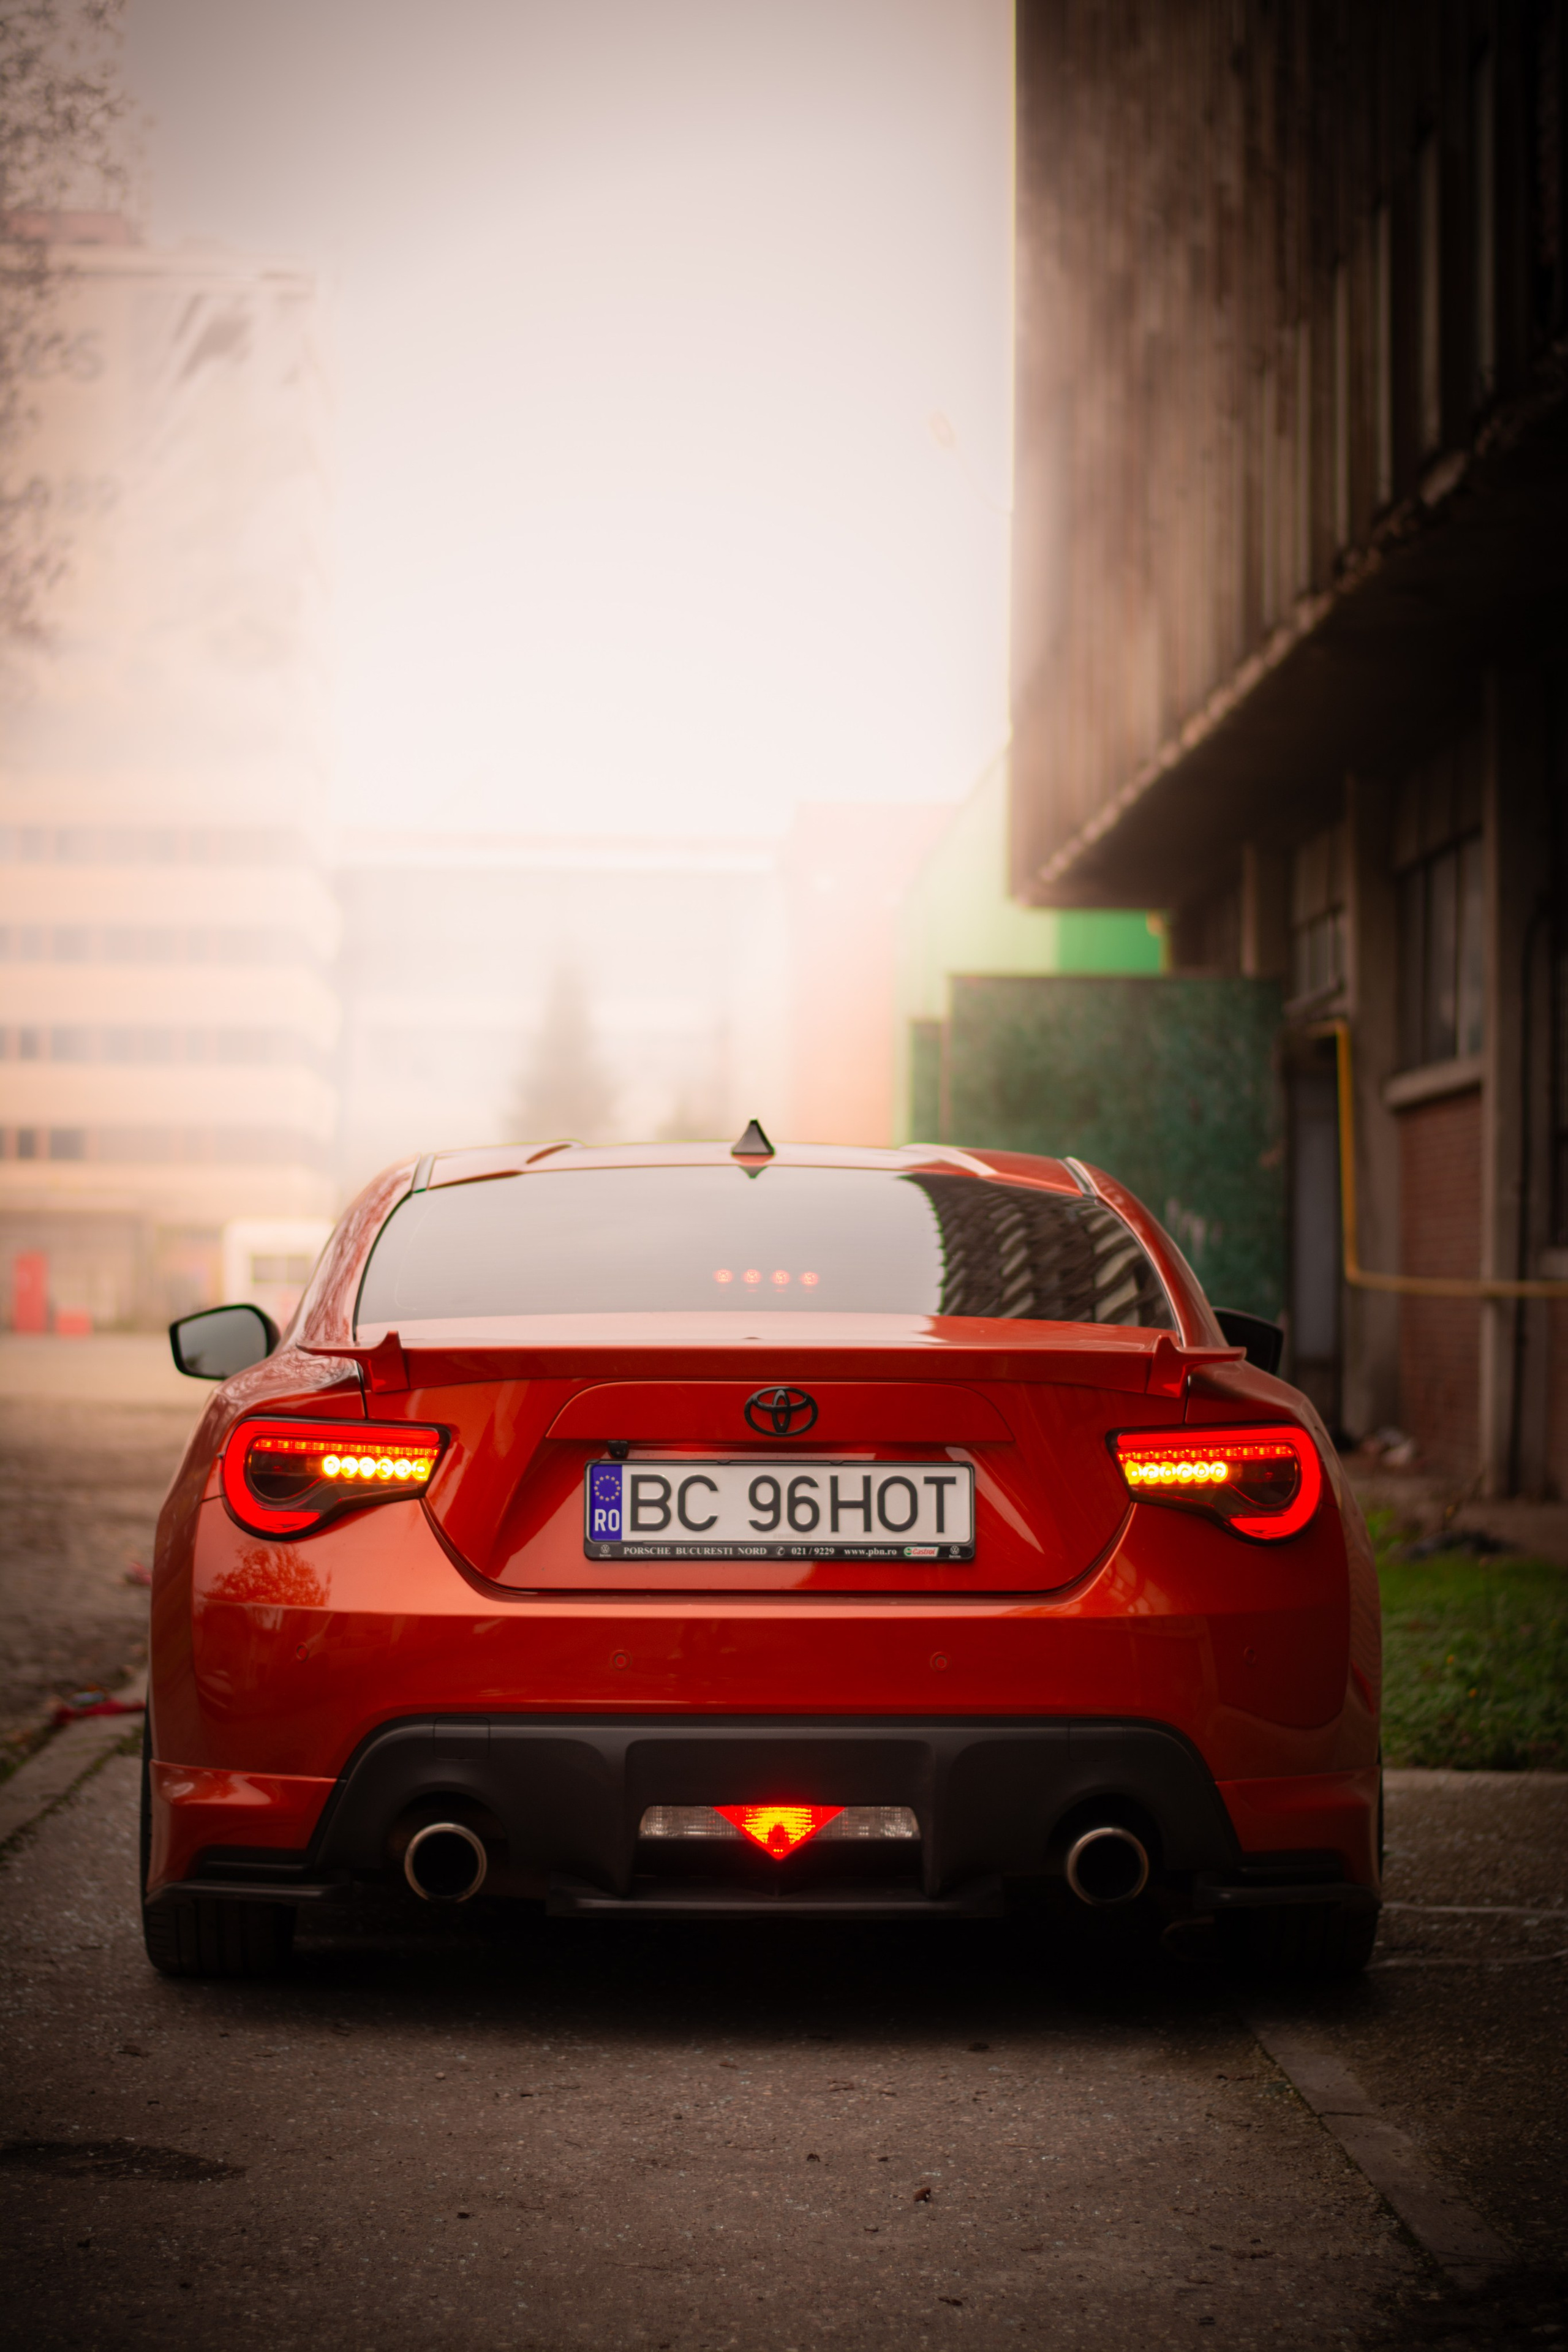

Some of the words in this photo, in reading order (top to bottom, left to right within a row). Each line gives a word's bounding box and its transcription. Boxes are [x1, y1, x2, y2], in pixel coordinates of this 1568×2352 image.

[630, 1474, 718, 1532] BC
[748, 1474, 957, 1533] 96HOT
[594, 1509, 620, 1532] RO
[623, 1547, 671, 1555] PORSCHE
[676, 1547, 733, 1555] BUCURESTI
[737, 1547, 767, 1555] NORD
[791, 1547, 806, 1555] 021
[814, 1547, 835, 1555] 9229
[844, 1547, 897, 1556] www.pbn.ro
